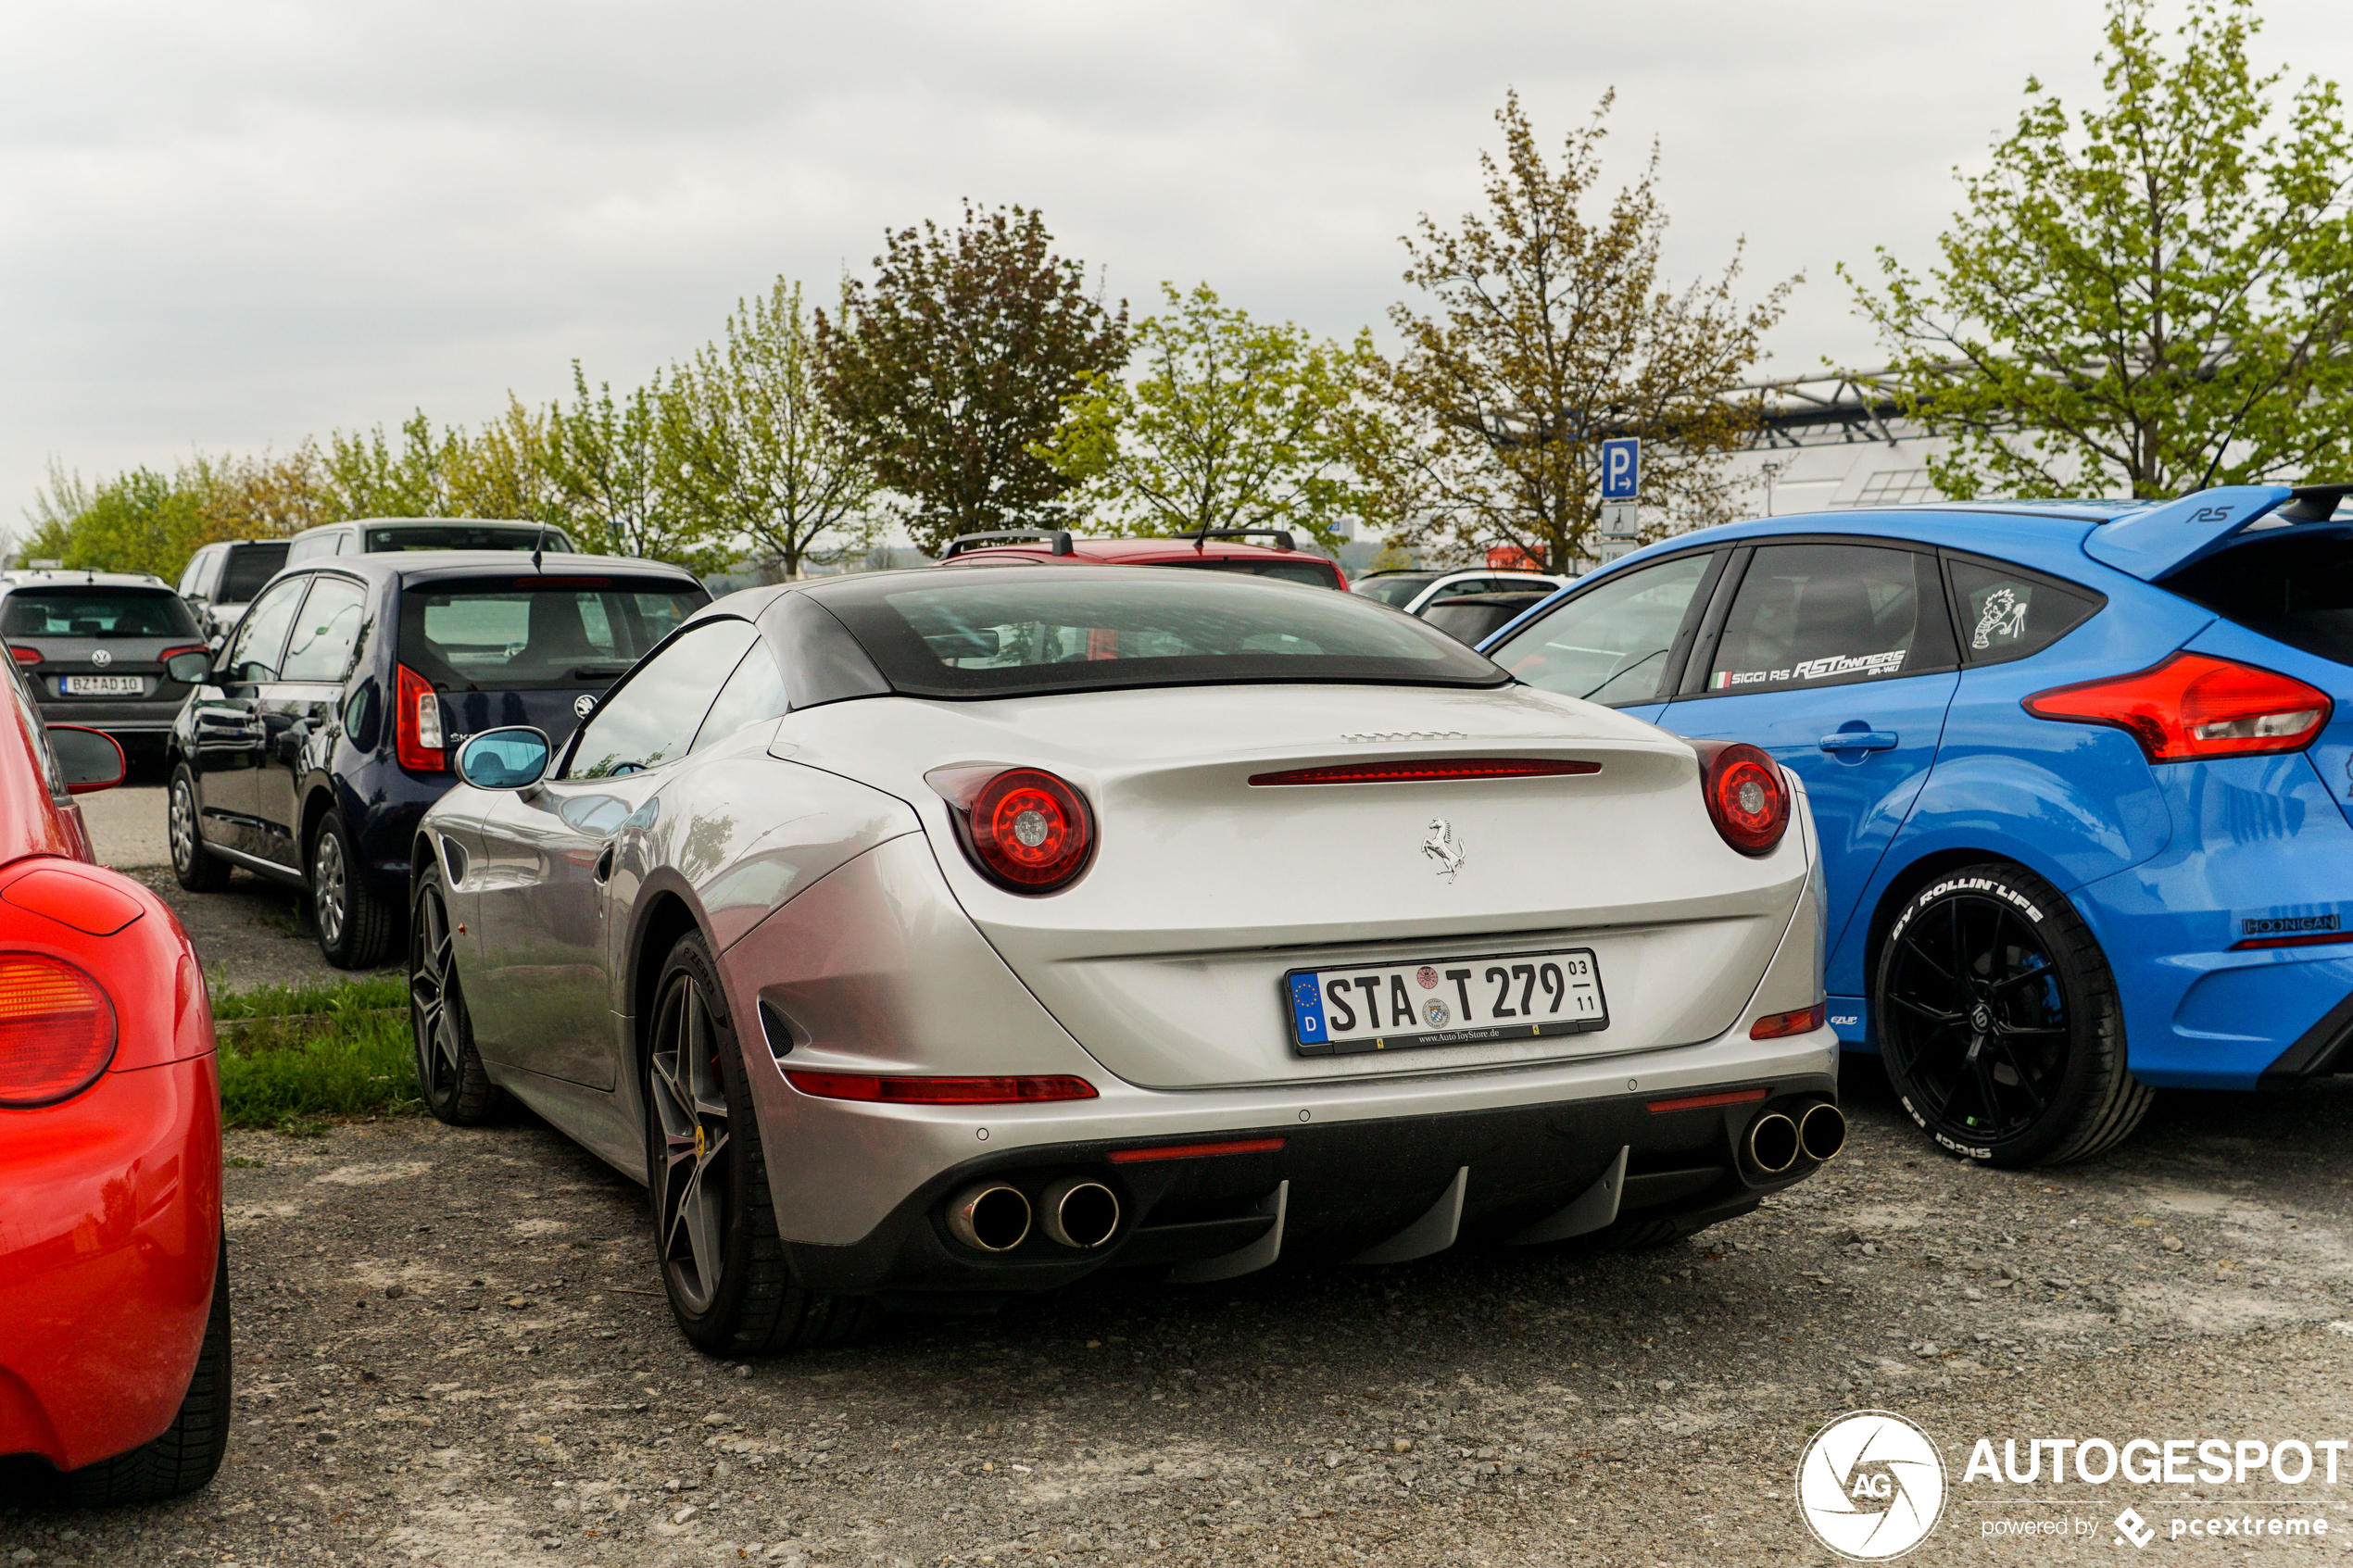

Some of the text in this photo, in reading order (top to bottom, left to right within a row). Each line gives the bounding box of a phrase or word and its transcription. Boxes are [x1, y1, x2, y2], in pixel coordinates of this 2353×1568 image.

[1610, 447, 1629, 491] P
[2185, 506, 2234, 523] RS
[73, 679, 137, 690] BZ AD 10
[1731, 671, 1767, 684] SIGGI
[1769, 669, 1790, 682] RS
[1893, 906, 1914, 941] BY
[1995, 884, 2045, 923] LIFE
[690, 951, 715, 995] ZERO
[1568, 960, 1587, 975] 03
[1327, 974, 1416, 1032] STA
[1445, 969, 1471, 1021] T
[1485, 963, 1565, 1018] 279
[1577, 996, 1593, 1010] 11
[1304, 1016, 1316, 1032] D
[1418, 1029, 1500, 1043] www.AutoToyStore.de
[1935, 1132, 1992, 1159] SIGGI
